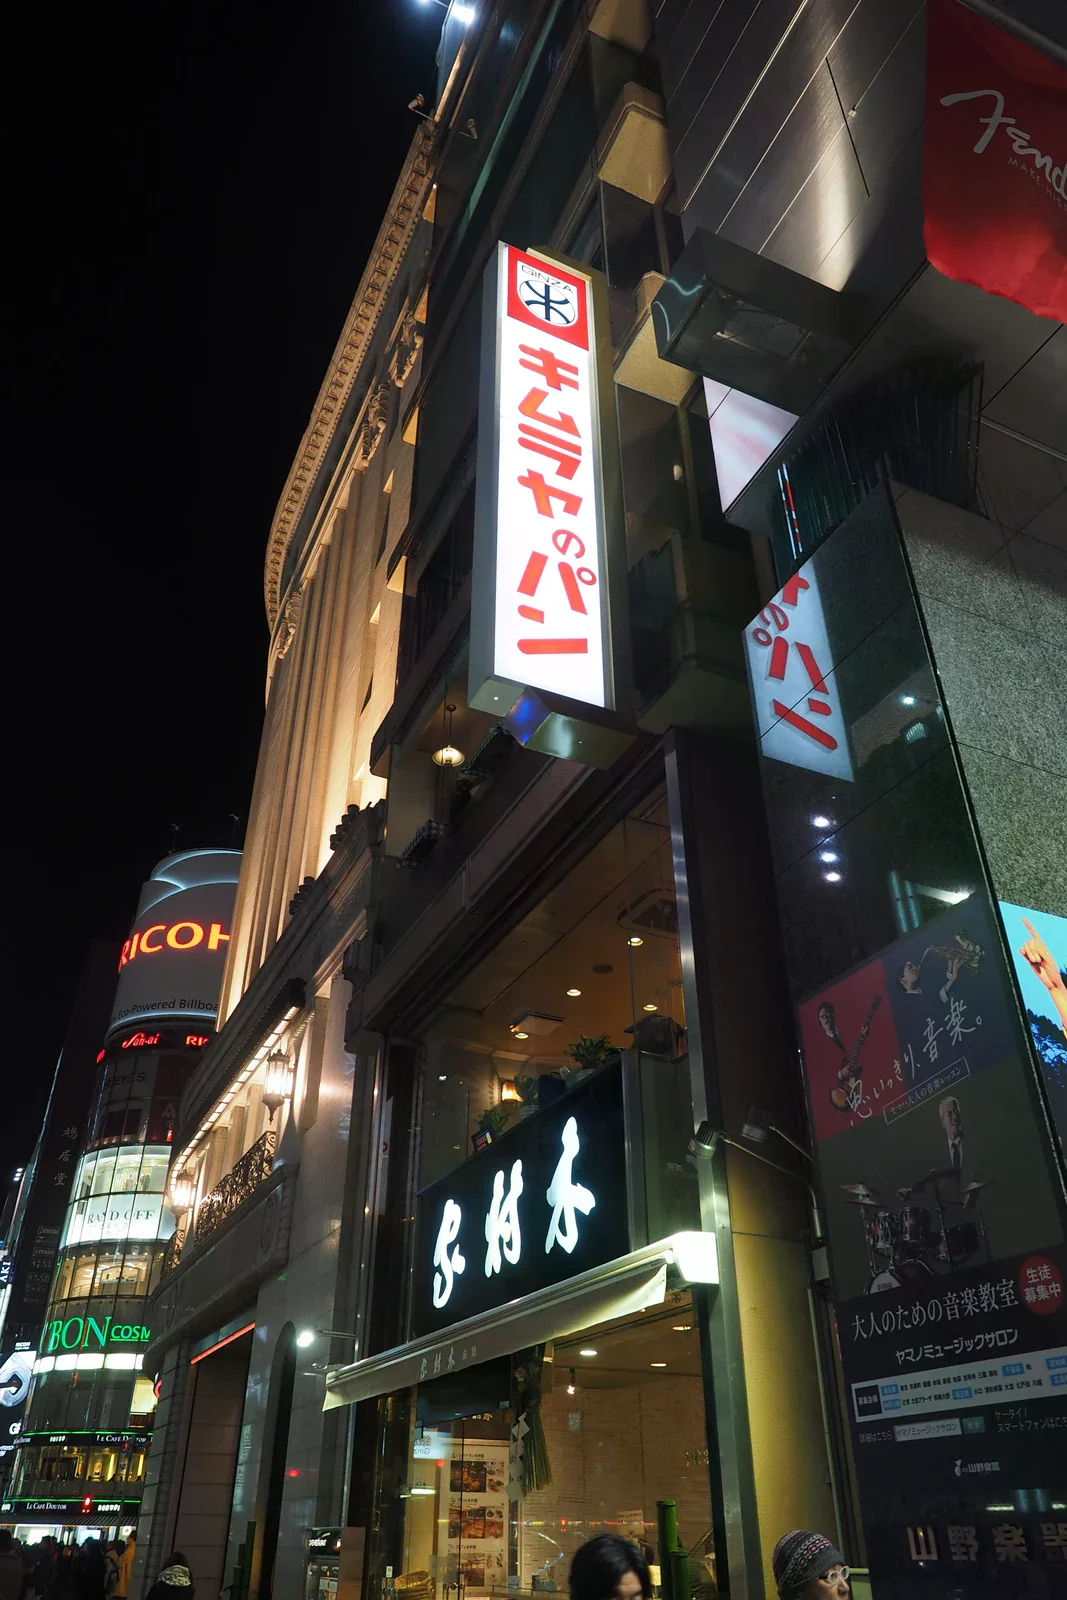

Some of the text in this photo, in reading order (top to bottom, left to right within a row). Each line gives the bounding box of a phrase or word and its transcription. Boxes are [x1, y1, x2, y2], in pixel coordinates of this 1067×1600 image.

[1008, 156, 1041, 186] MAKE
[521, 264, 574, 294] GINZA
[517, 343, 598, 655] キムラヤのパン
[118, 998, 176, 1019] Eco-Powered
[54, 1126, 79, 1186] 鳩居堂
[1025, 1264, 1052, 1284] 生徒
[1024, 1281, 1062, 1303] 募集中
[851, 1278, 1019, 1342] 大人のための音楽教室
[40, 1316, 112, 1352] BON
[896, 1327, 1019, 1365] ヤマノミュージックサロン
[896, 1423, 958, 1437] ヤマノミュージックサロン
[907, 1522, 1067, 1562] 山野楽器
